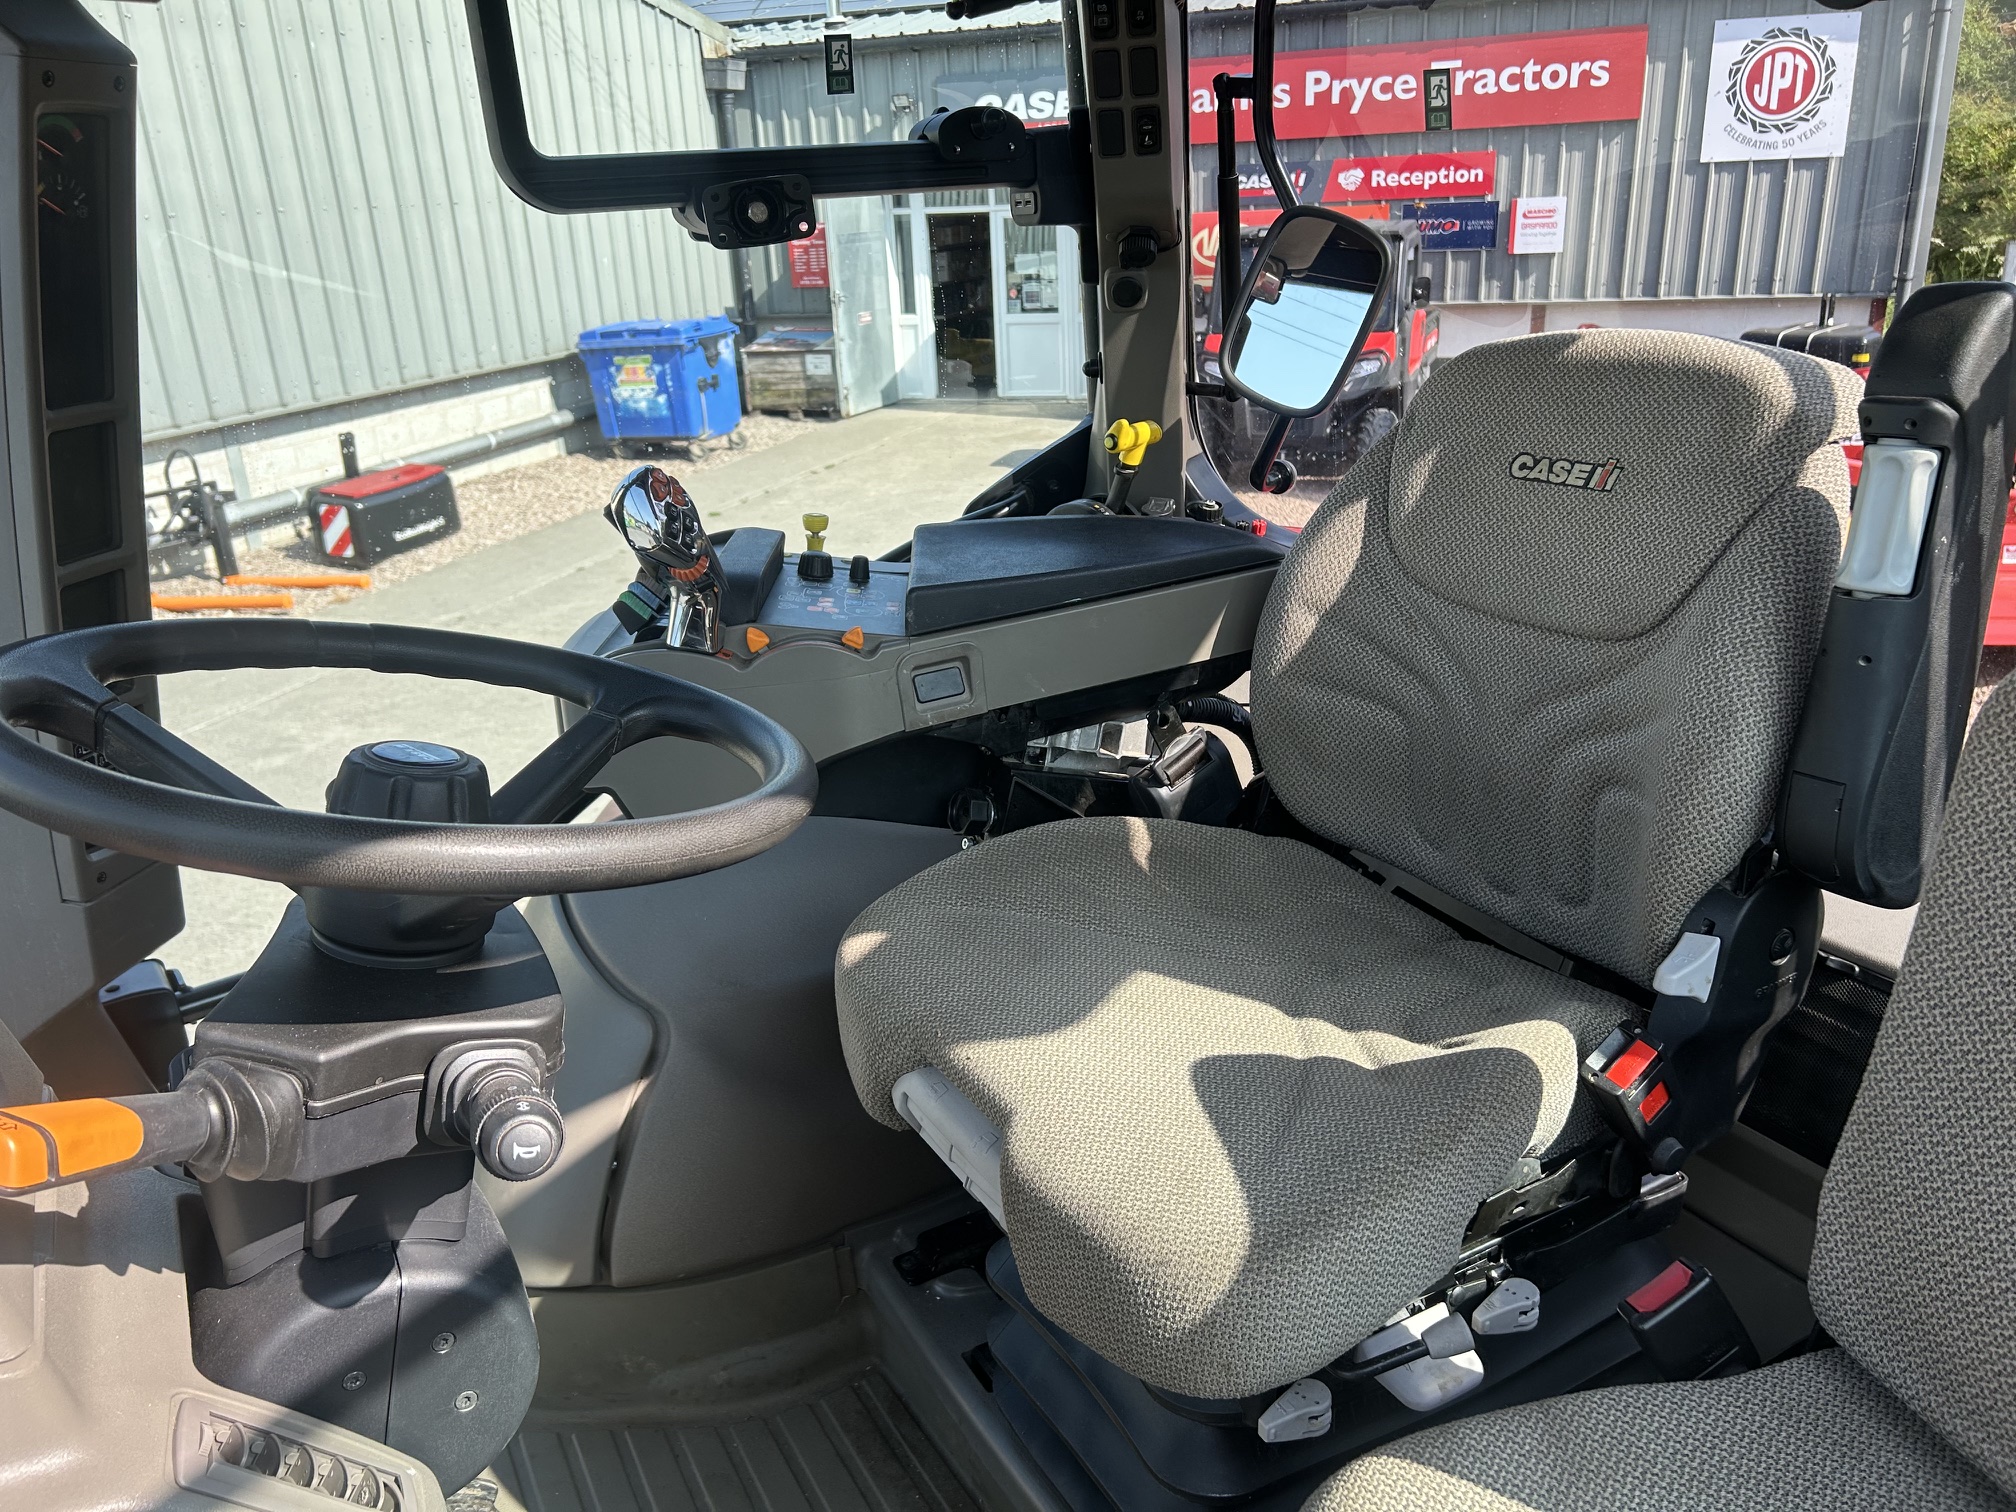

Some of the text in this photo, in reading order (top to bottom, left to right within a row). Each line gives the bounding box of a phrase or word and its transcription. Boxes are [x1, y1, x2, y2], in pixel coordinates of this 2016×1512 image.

[1305, 70, 1417, 114] Pryce
[1753, 51, 1808, 110] JPT
[1723, 119, 1827, 151] CELEBRATING 50 YEARS
[1371, 165, 1484, 190] Reception
[1418, 217, 1456, 235] UMO
